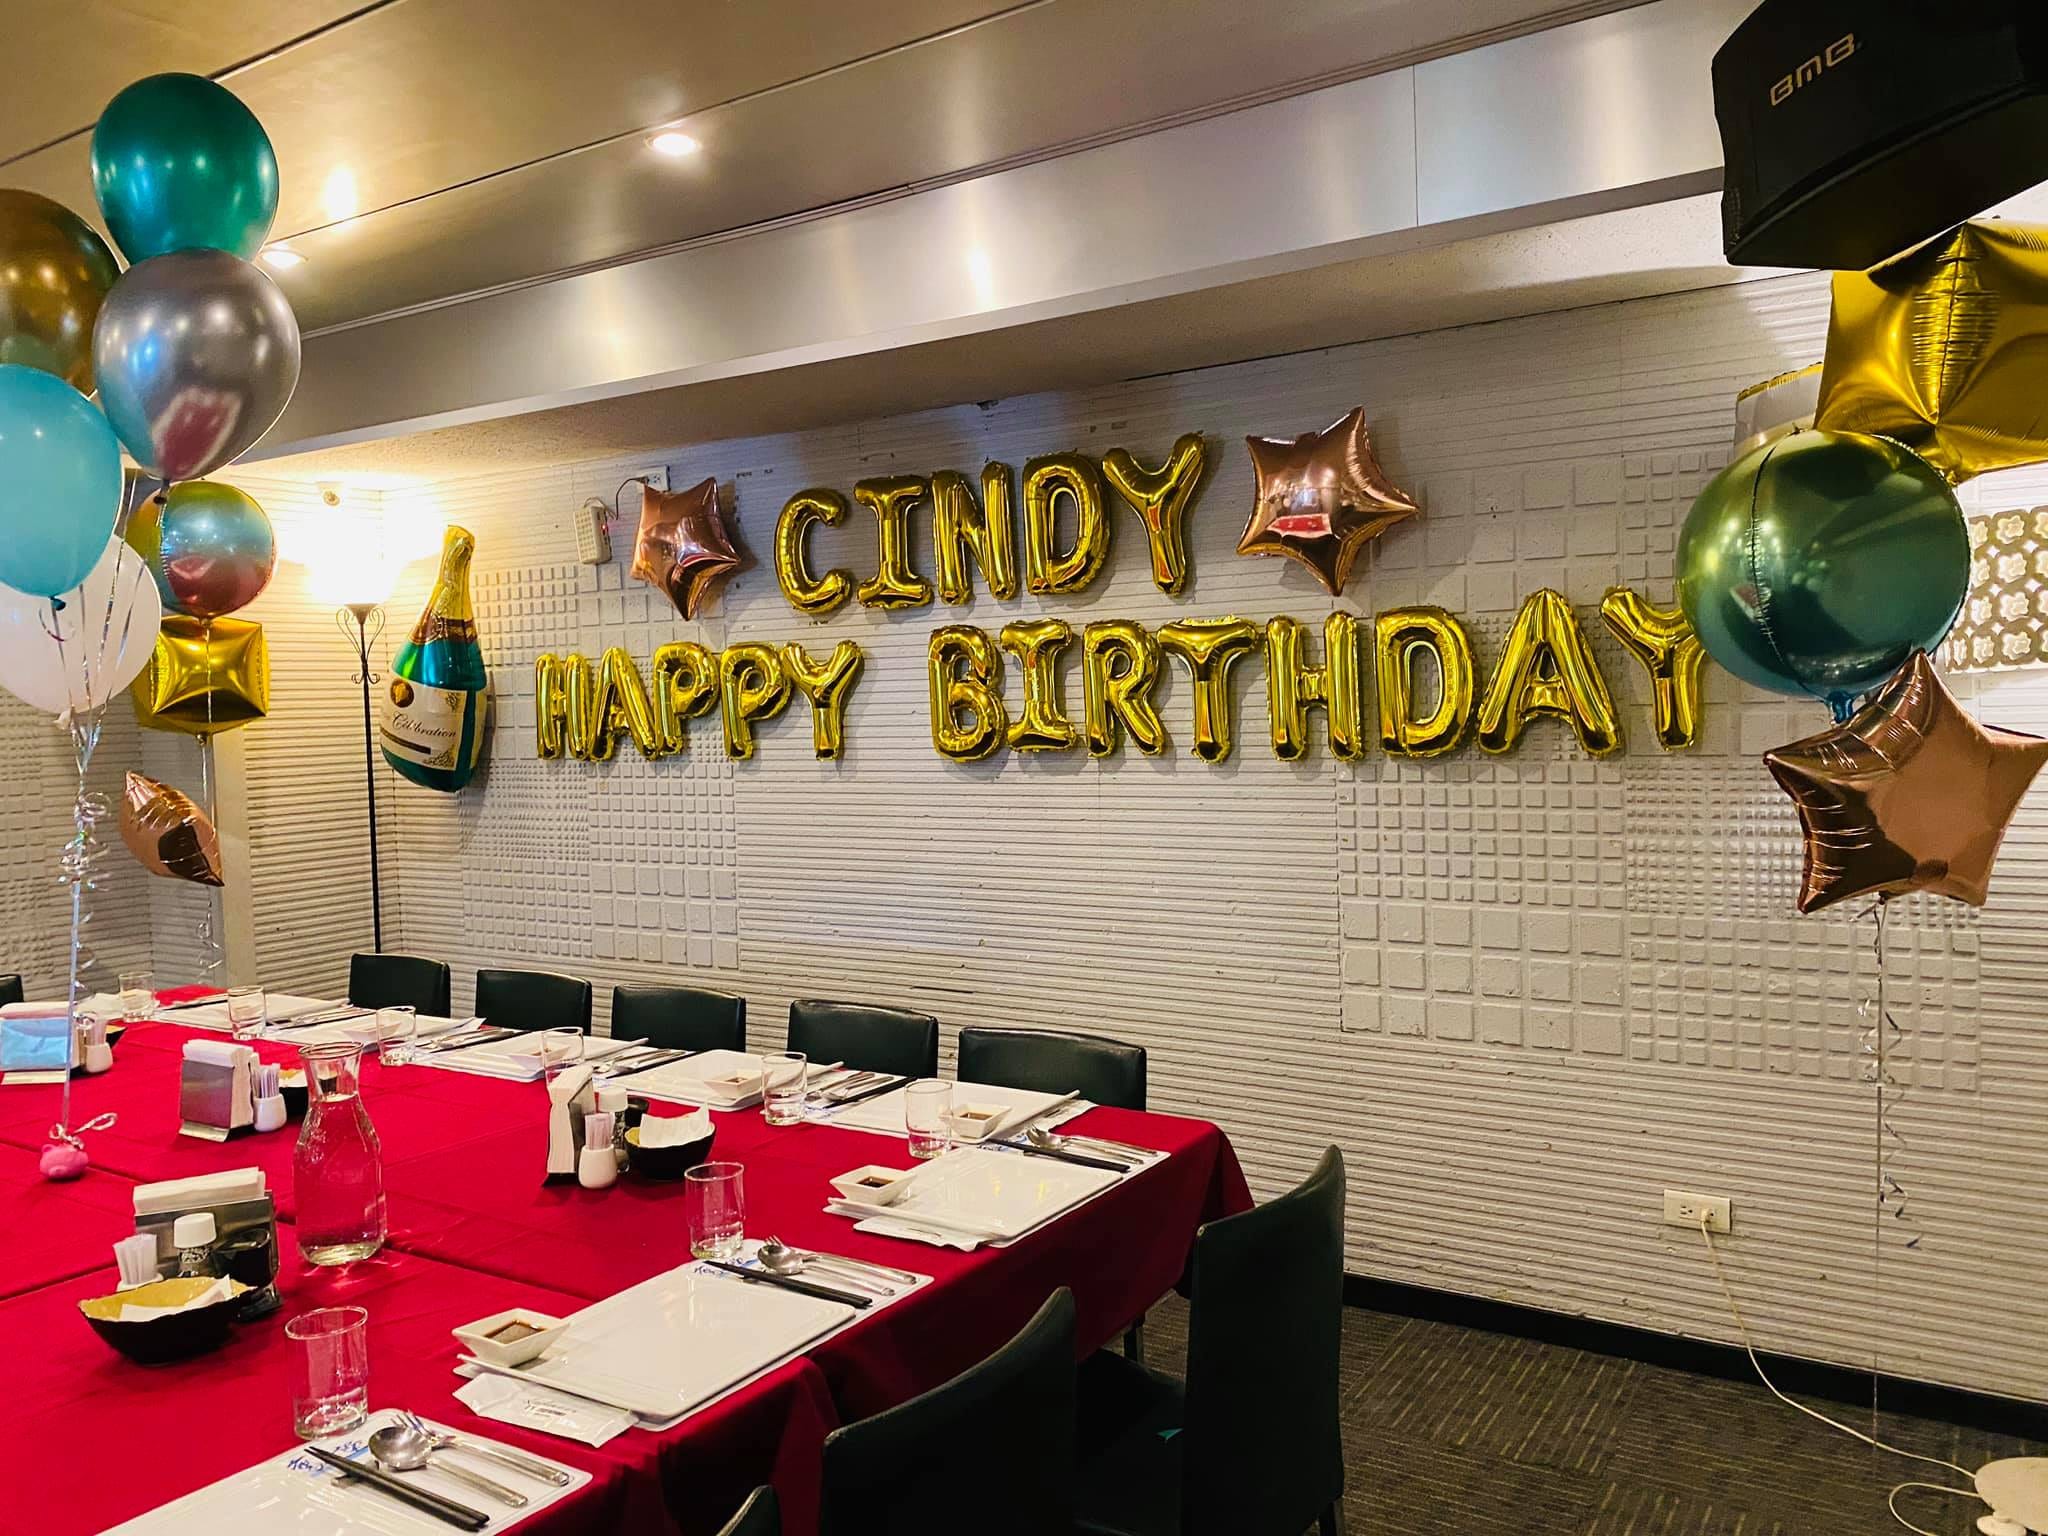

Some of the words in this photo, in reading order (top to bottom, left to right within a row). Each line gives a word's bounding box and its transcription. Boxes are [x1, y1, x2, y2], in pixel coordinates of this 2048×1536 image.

[1769, 33, 1855, 106] BMB
[773, 432, 1205, 614] CINDY
[535, 639, 865, 761] HAPPY
[928, 587, 1706, 763] BIRTHDAY
